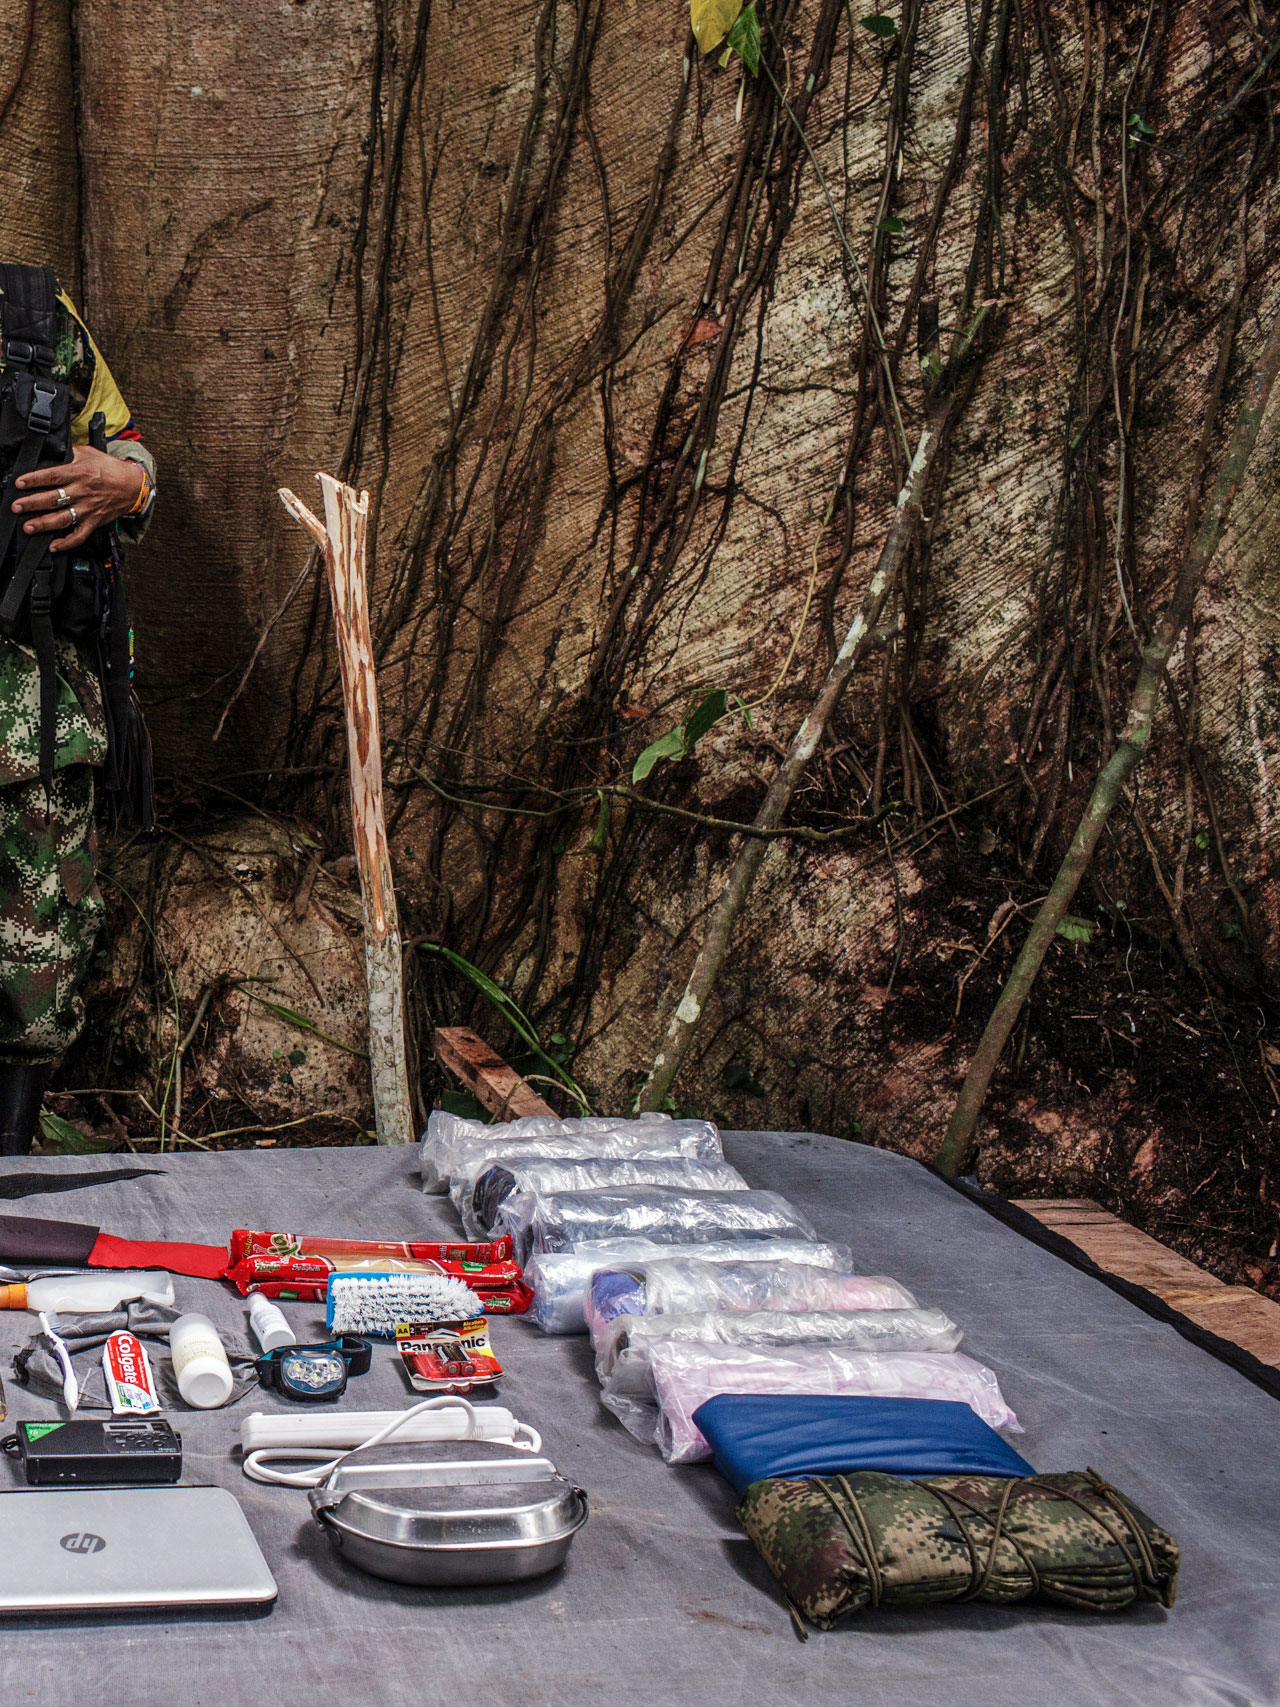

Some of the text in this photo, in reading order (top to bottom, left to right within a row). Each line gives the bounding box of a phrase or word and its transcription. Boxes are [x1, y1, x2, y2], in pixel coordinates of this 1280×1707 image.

[400, 1336, 486, 1352] Pannic
[117, 1335, 138, 1384] Colgate
[63, 1533, 102, 1553] hp
